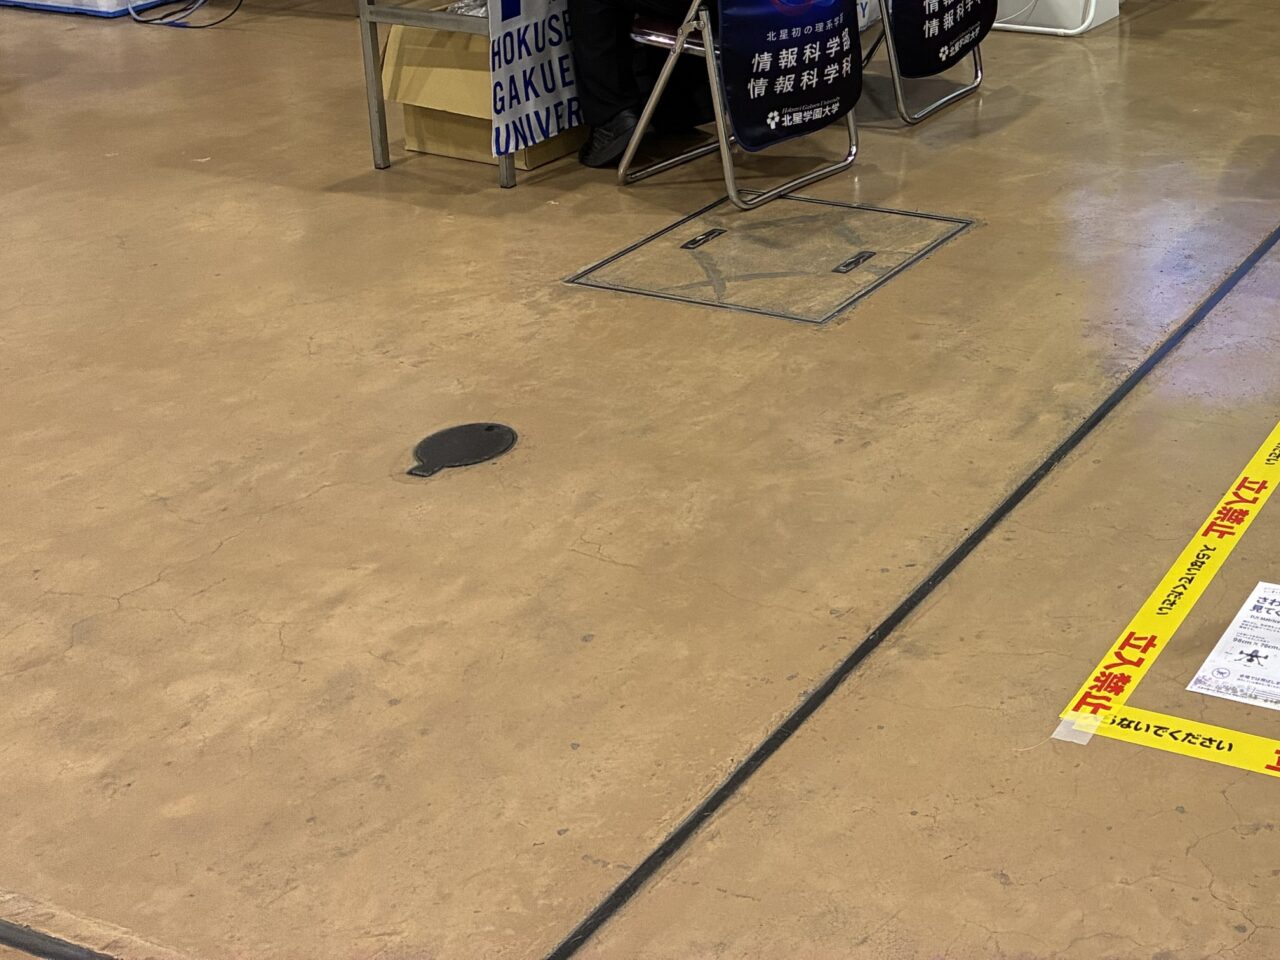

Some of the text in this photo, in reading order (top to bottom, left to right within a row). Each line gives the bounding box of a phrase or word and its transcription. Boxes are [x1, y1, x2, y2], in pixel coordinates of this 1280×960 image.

[751, 28, 851, 73] 情報科学部
[747, 54, 852, 99] 情報科学科
[781, 103, 840, 127] 北星学園大学
[1201, 476, 1268, 539] 立入禁止
[1157, 544, 1216, 616] 入らないでください
[1072, 631, 1157, 716] 立入禁止
[1108, 715, 1234, 753] らないでください
